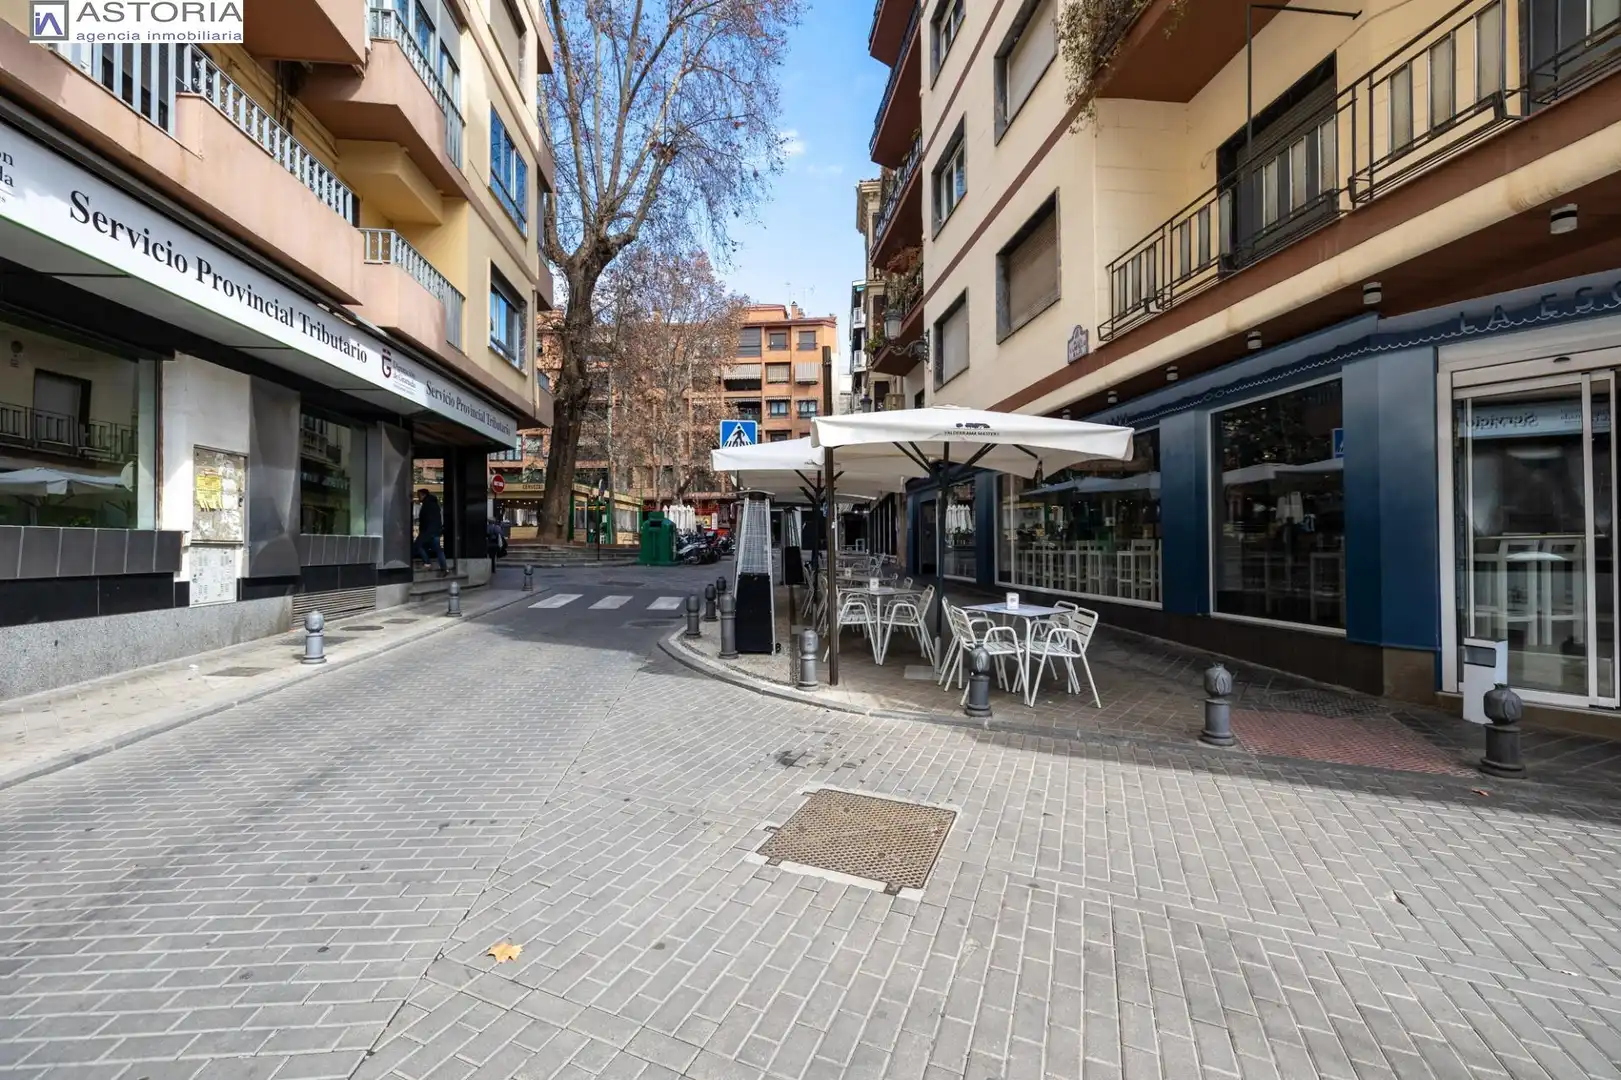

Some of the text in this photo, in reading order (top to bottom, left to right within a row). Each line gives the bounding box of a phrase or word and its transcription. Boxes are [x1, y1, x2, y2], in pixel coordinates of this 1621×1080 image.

[70, 190, 367, 364] Servicio Provincial Tributario
[1459, 304, 1509, 331] LA
[426, 380, 455, 408] Servicio
[456, 396, 486, 424] Provincial
[486, 411, 511, 436] Tributario
